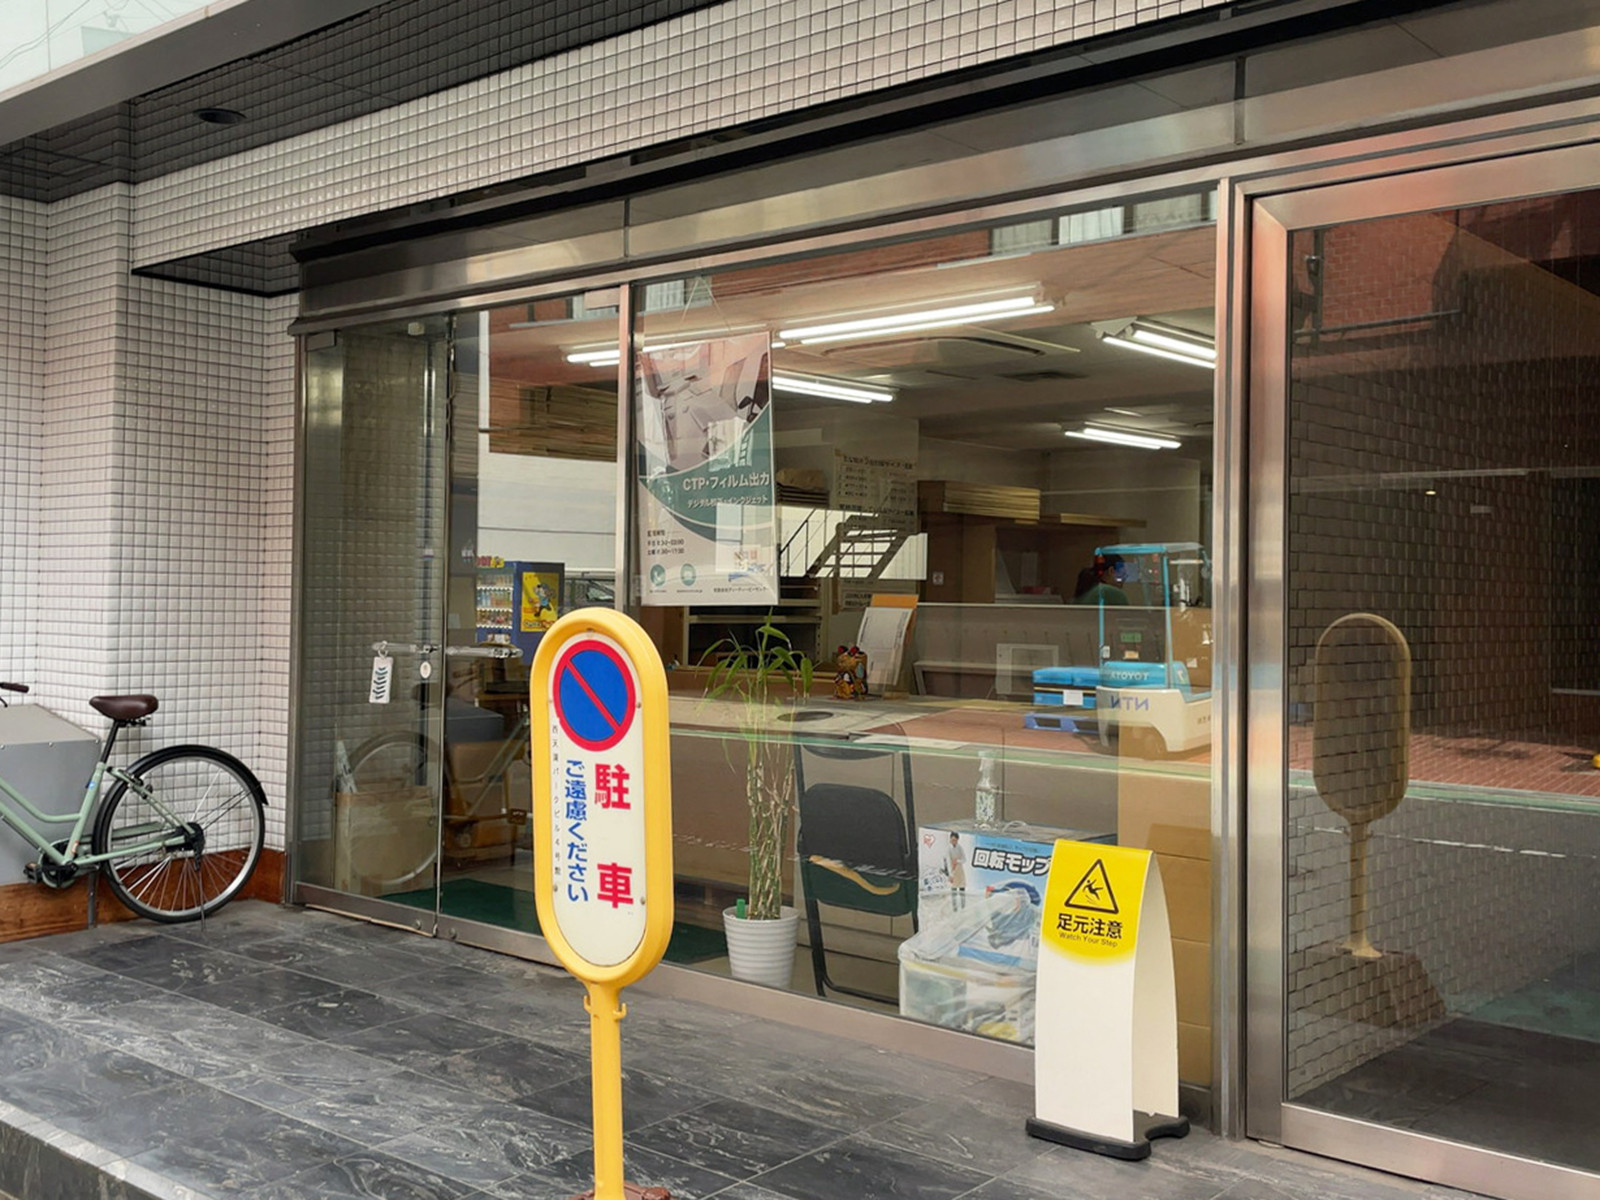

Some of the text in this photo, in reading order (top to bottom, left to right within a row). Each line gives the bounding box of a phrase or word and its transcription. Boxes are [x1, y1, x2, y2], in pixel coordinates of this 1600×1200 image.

[565, 760, 588, 902] ご遠慮ください
[1056, 913, 1122, 939] 足元注意
[1059, 931, 1118, 948] Watch Your Step
